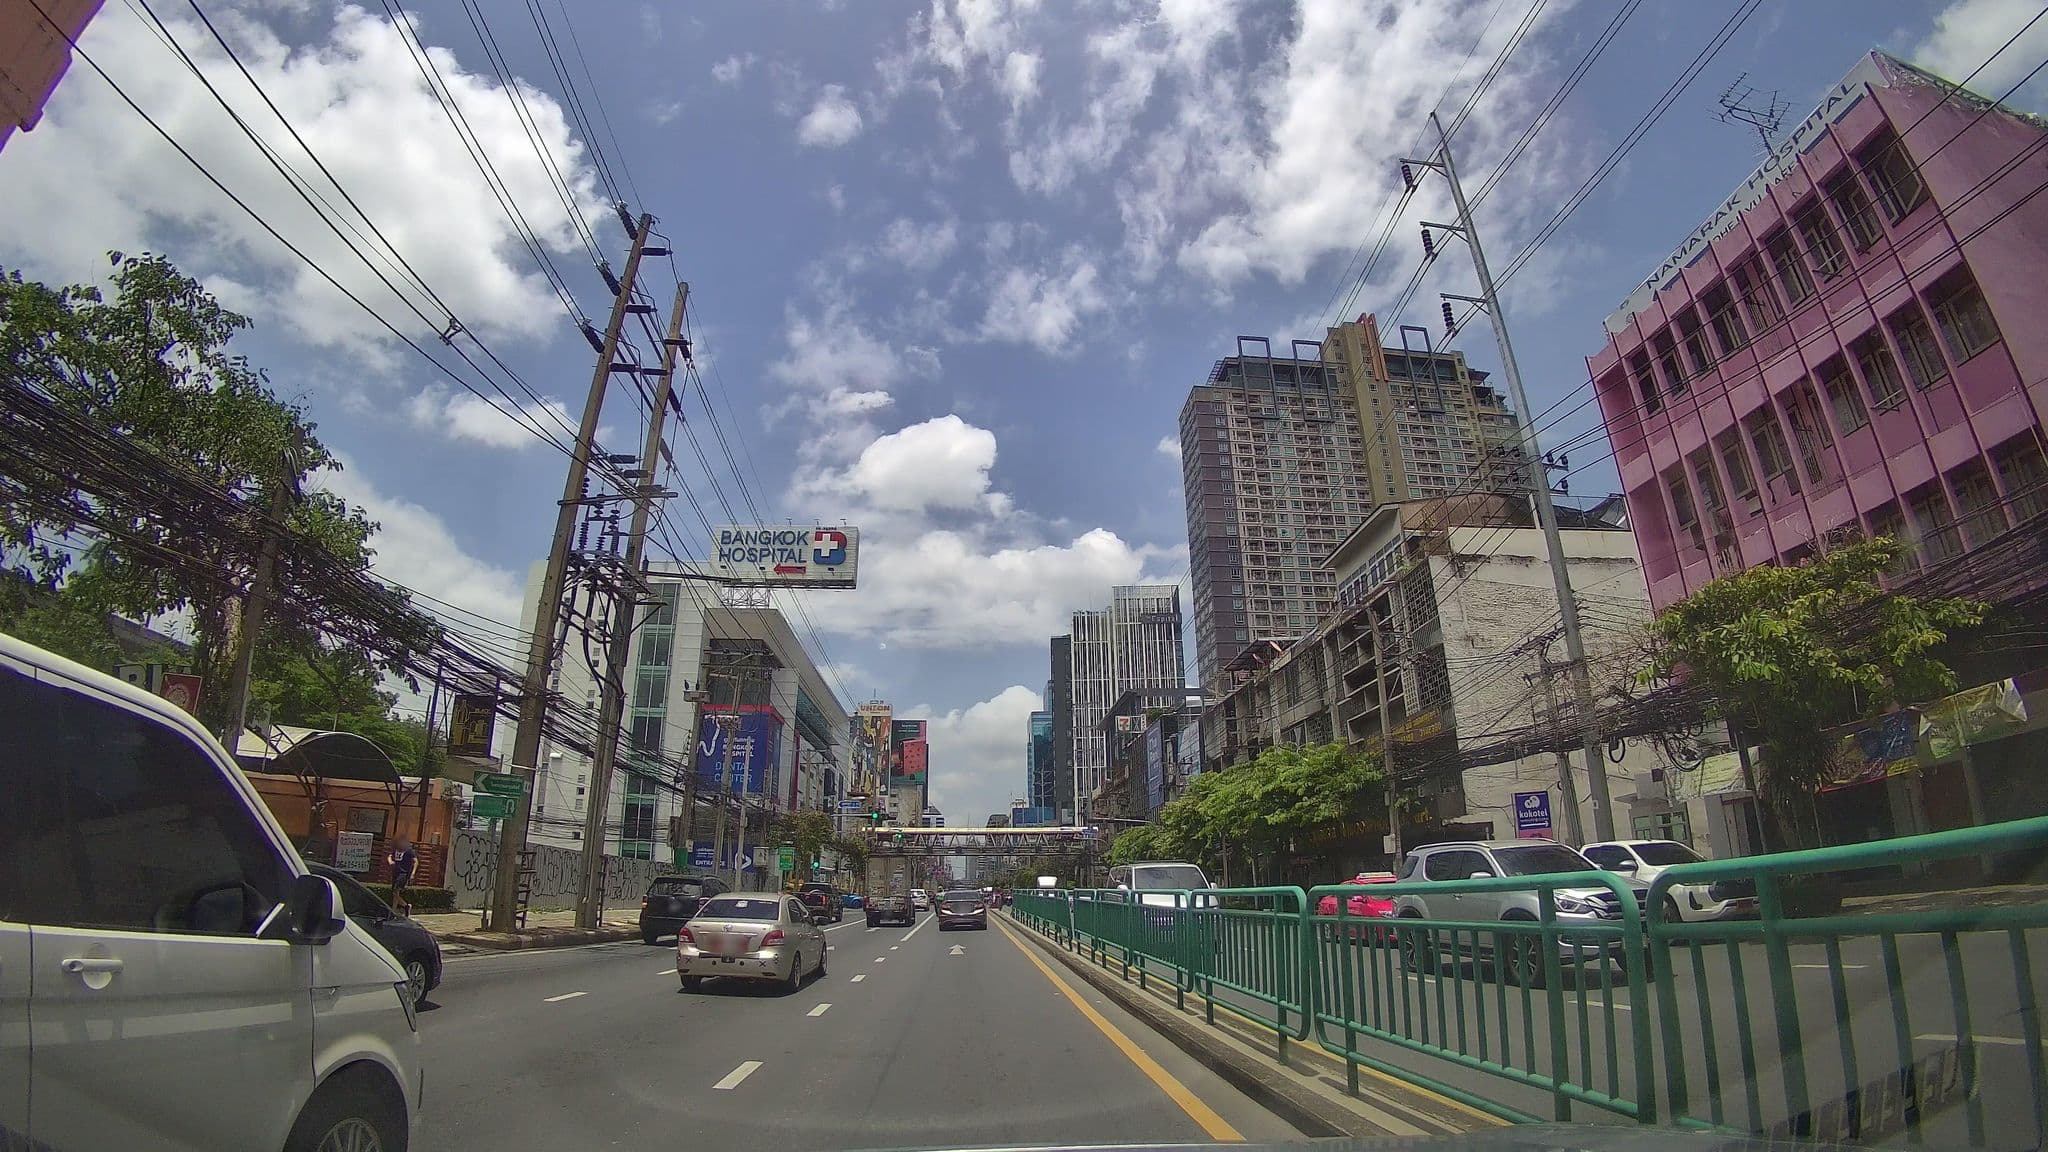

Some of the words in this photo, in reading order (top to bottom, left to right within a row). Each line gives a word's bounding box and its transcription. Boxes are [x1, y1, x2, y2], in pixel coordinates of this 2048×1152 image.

[1644, 193, 1742, 290] NAMARAK
[1747, 82, 1858, 189] HOSPITAL
[720, 530, 809, 546] BANGKOK
[718, 547, 807, 563] HOSPITAL
[1519, 808, 1548, 818] kokotel
